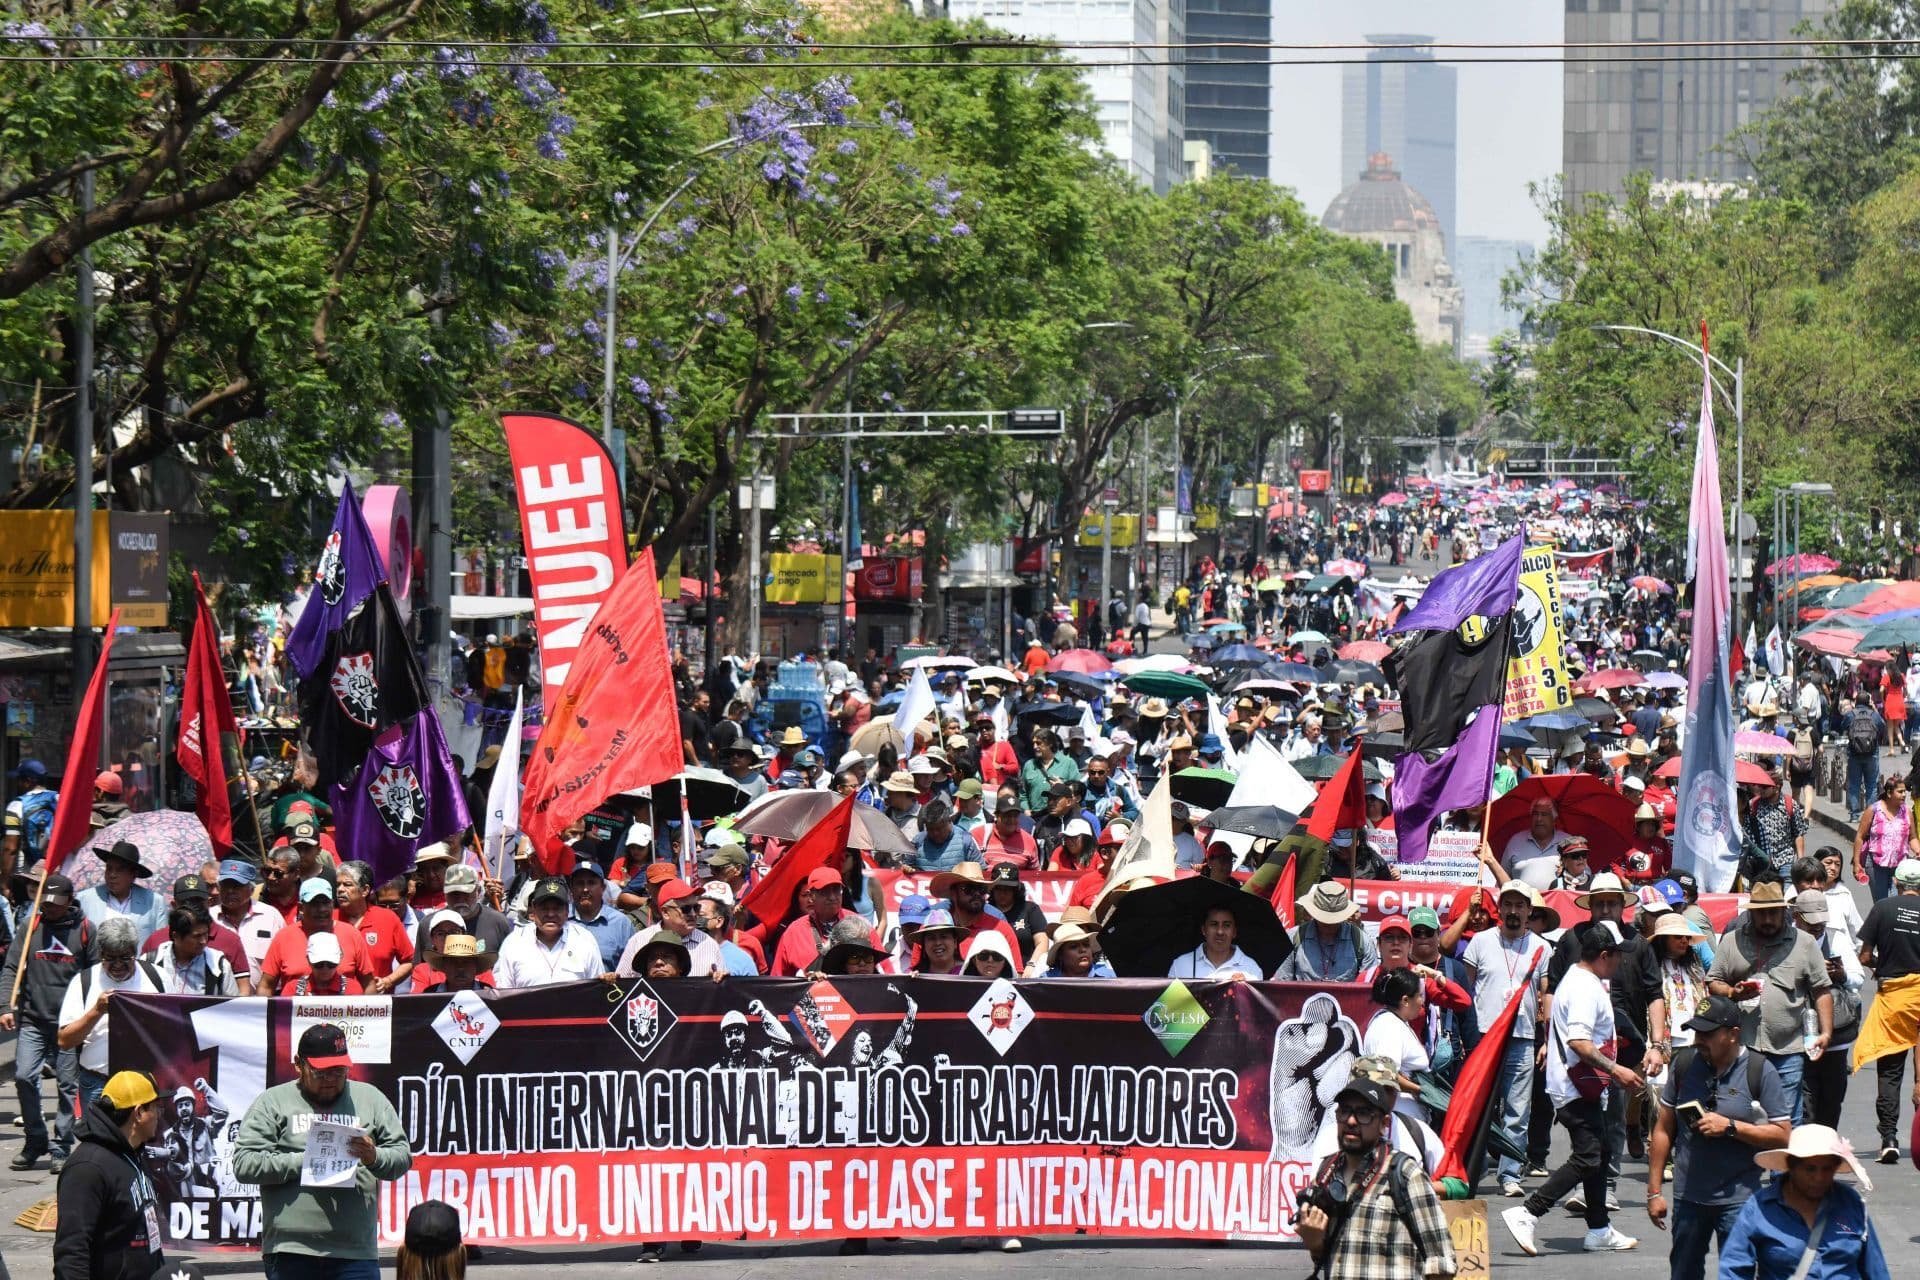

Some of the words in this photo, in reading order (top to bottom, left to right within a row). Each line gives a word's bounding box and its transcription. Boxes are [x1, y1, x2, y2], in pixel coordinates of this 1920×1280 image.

[778, 569, 818, 577] mercado
[778, 577, 801, 585] pago
[1417, 870, 1429, 878] Ley
[296, 1004, 344, 1018] Asamblea
[346, 1004, 389, 1018] Nacional
[448, 1037, 485, 1048] CNTE
[398, 1063, 470, 1156] DÍA
[476, 1067, 788, 1158] INTERNACIONAL
[798, 1064, 848, 1148] DE
[856, 1064, 931, 1148] LOS
[937, 1064, 1238, 1149] TRABAJADORES
[600, 1160, 777, 1238] UNITARIO,
[788, 1160, 838, 1230] DE
[844, 1158, 954, 1230] CLASE
[966, 1157, 986, 1228] E
[170, 1200, 211, 1240] DE
